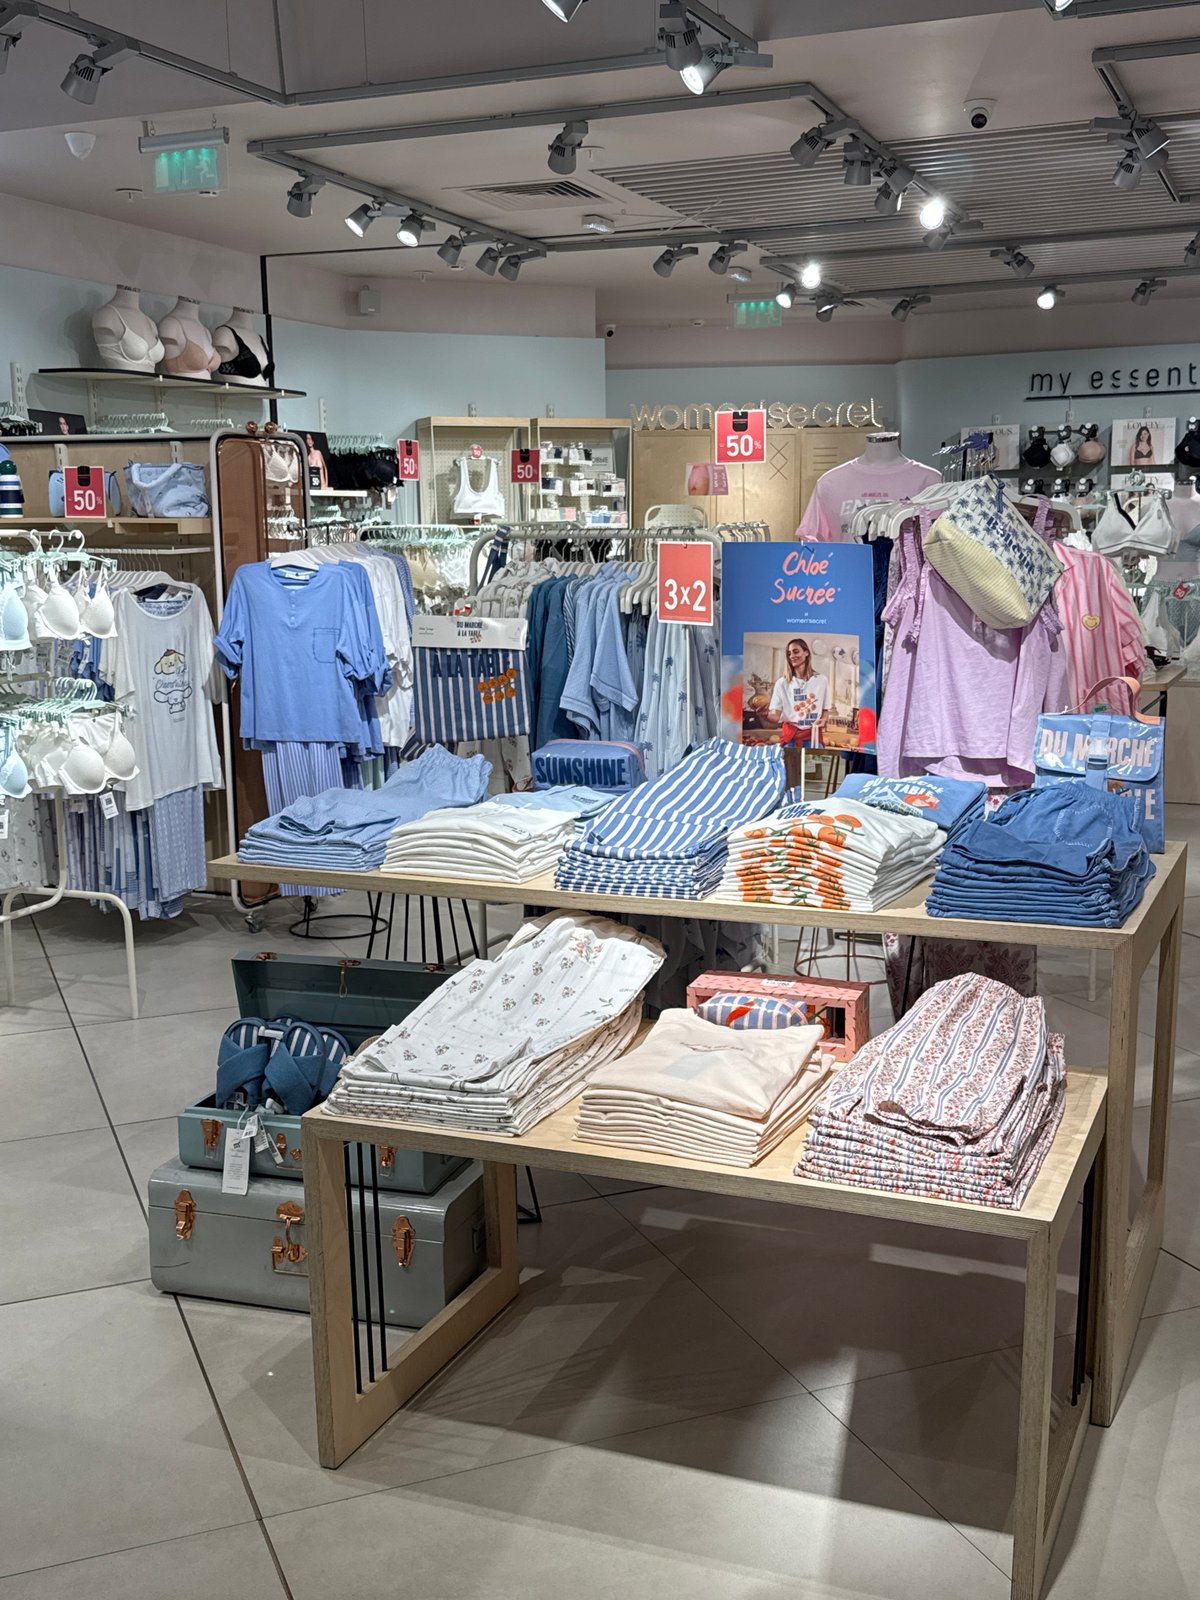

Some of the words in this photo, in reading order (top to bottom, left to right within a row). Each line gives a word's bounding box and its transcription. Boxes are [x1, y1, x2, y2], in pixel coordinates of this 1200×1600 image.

[1030, 372, 1072, 394] my
[1090, 362, 1198, 390] essent
[630, 397, 884, 432] wom'secret
[782, 549, 834, 576] Chloé
[664, 578, 707, 612] 3x2
[770, 578, 836, 605] Sucrée
[446, 654, 464, 677] LA
[1039, 728, 1069, 758] DU
[1072, 733, 1157, 768] MRCHÉ
[534, 757, 627, 786] SUNSHINE
